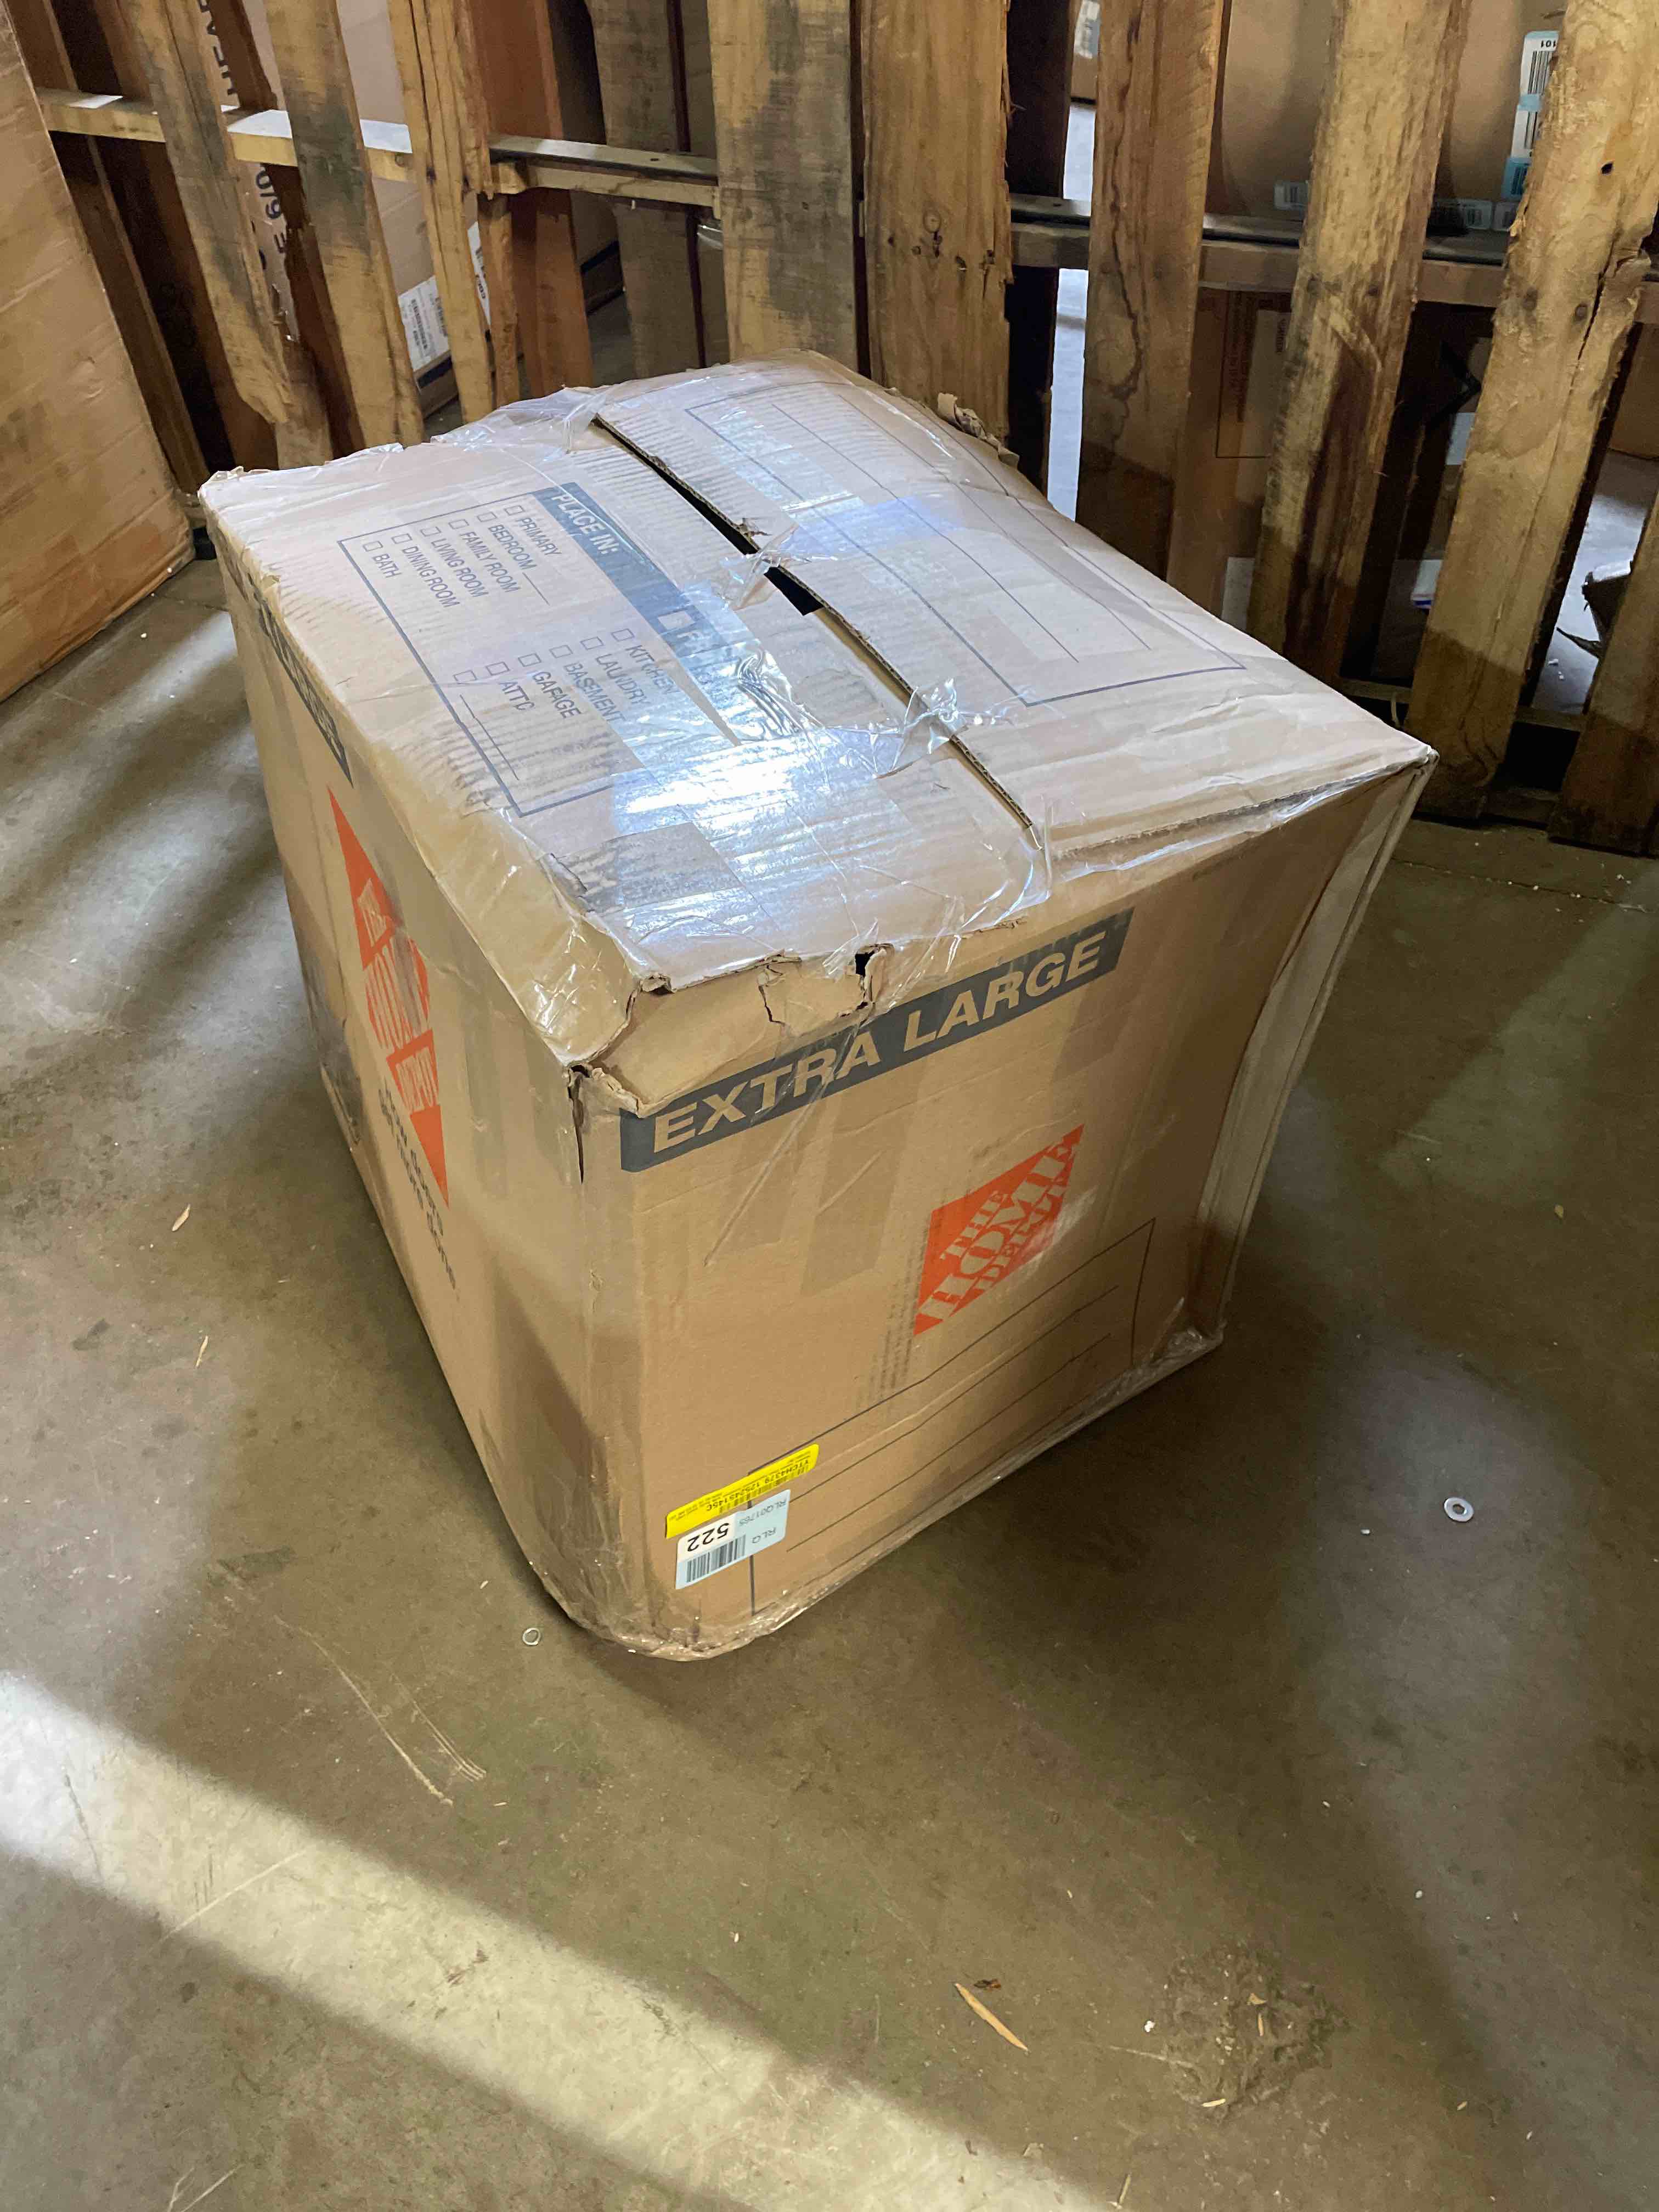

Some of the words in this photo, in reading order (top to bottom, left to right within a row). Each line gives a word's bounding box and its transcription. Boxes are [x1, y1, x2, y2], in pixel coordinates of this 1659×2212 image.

[488, 524, 538, 569] BEDROOM
[515, 517, 562, 555] PRIMARY
[551, 494, 606, 534] PLACE
[589, 534, 619, 554] IN:
[372, 553, 402, 578] BATH
[402, 546, 437, 577] DINING
[424, 577, 460, 608] ROOM
[431, 538, 465, 567] LIVING
[453, 567, 489, 597] ROOM
[459, 531, 500, 561] FAMILY
[484, 562, 521, 592] ROOM
[532, 672, 581, 718] GARAGE
[563, 661, 627, 721] BASEMENT
[595, 653, 650, 704] LAUNDRY
[654, 1031, 881, 1153] EXTRA
[904, 930, 1106, 1052] LARGE
[918, 1141, 1076, 1319] HOME
[687, 1522, 730, 1552] 522
